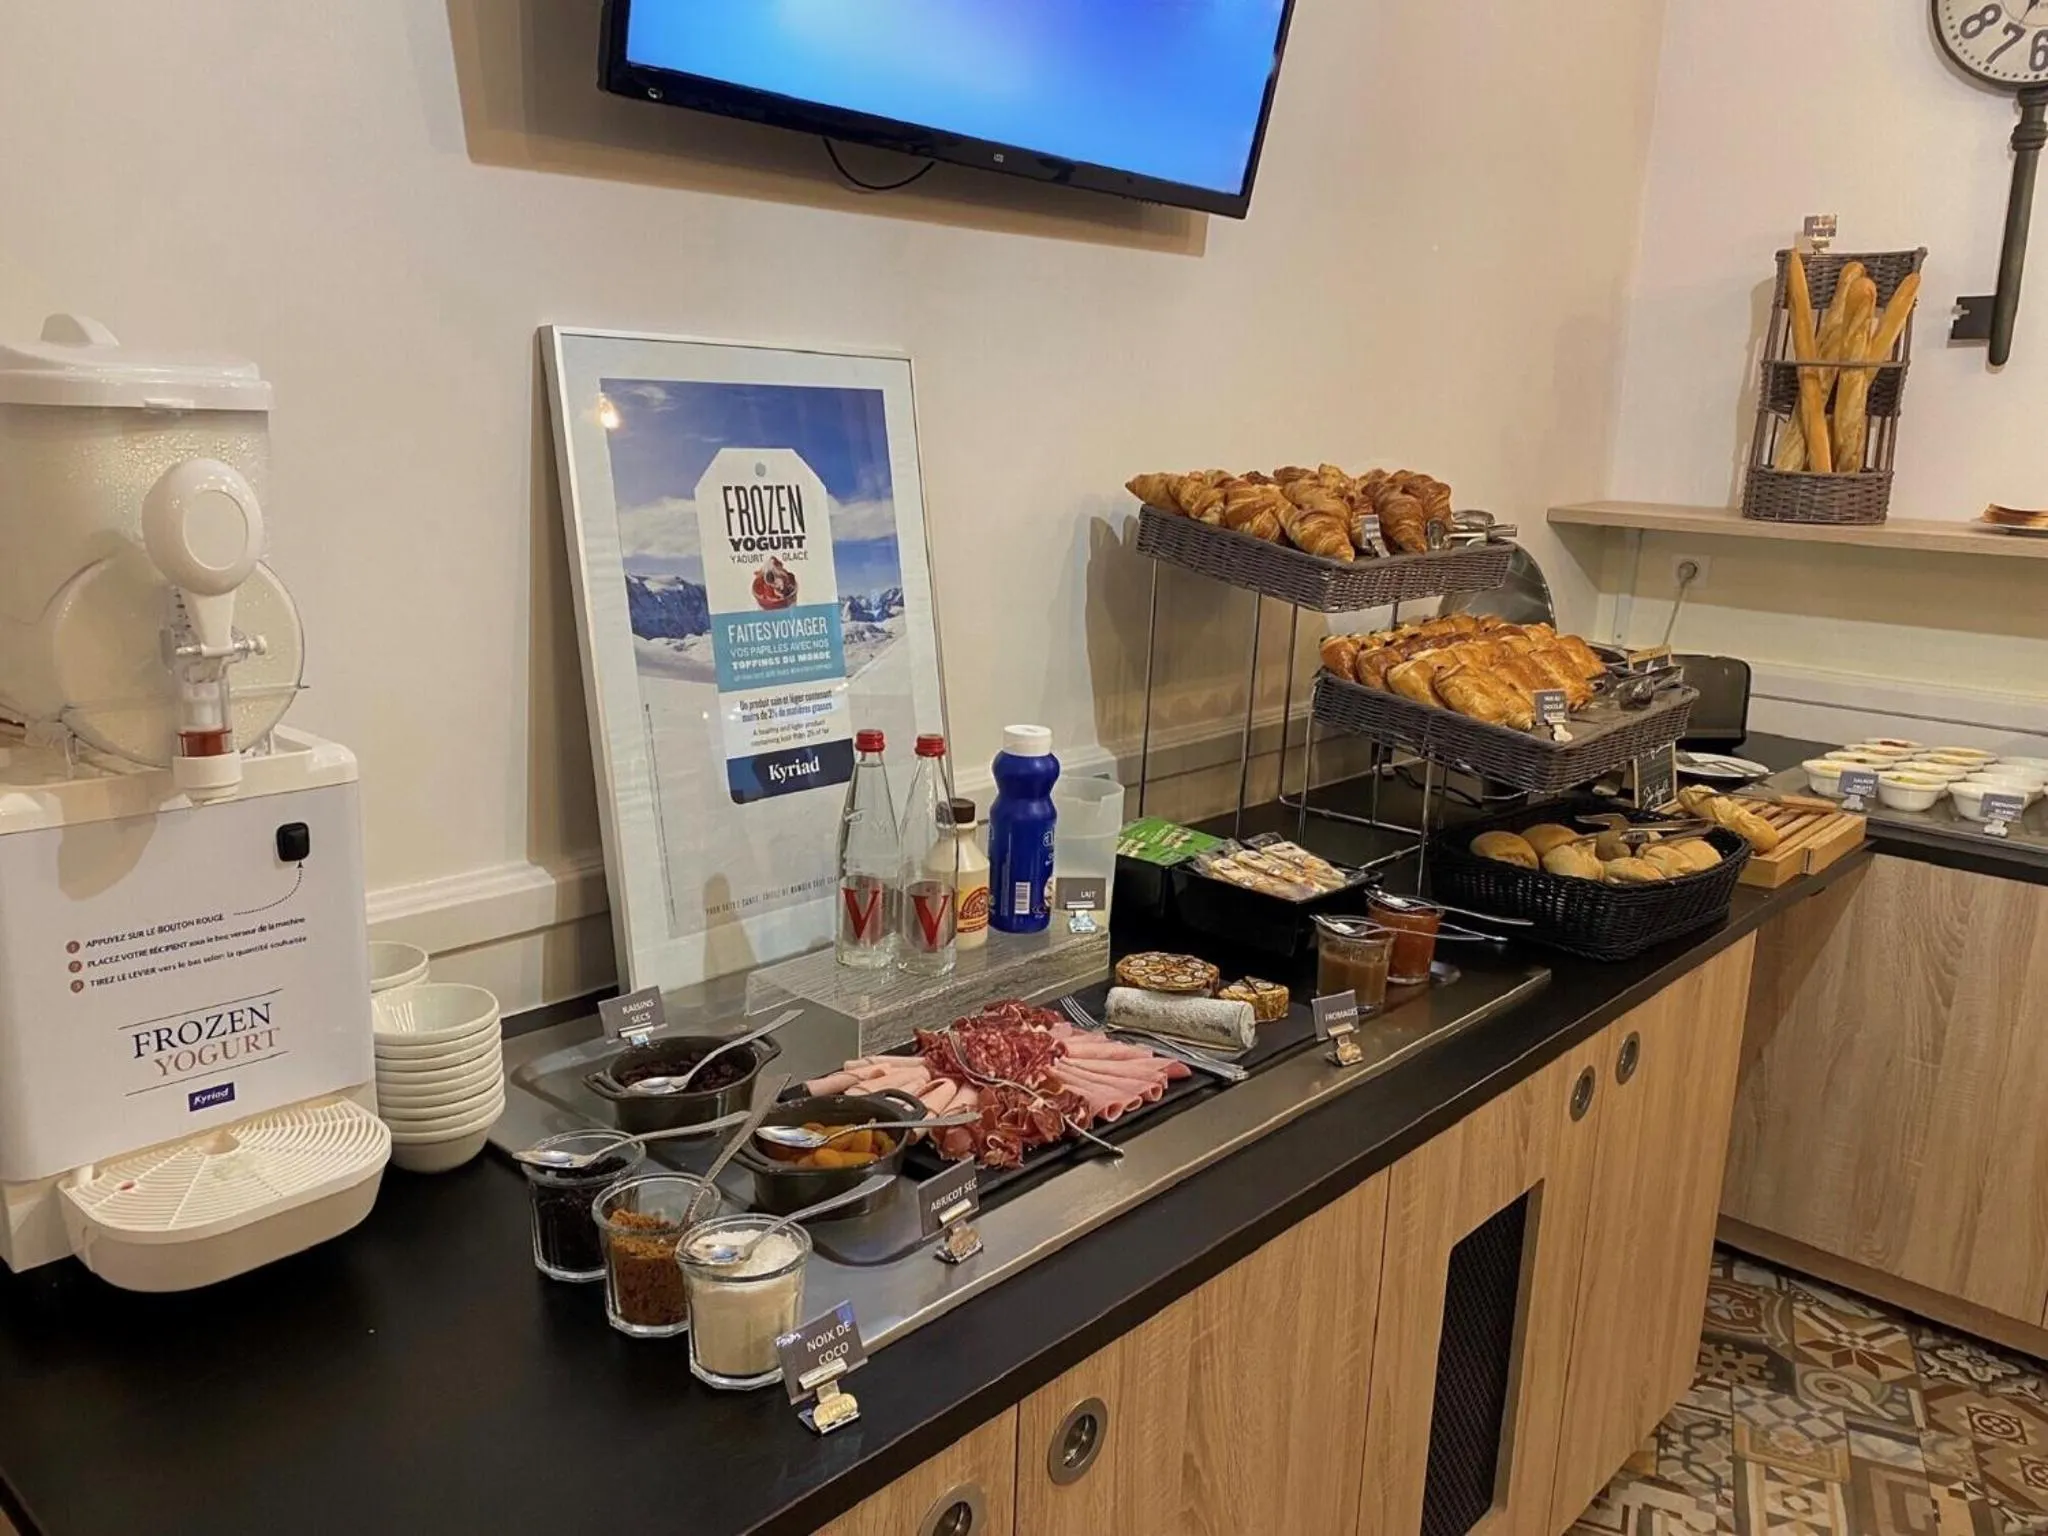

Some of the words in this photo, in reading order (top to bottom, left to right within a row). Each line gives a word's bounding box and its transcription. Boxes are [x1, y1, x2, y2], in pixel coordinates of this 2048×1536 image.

[1960, 3, 2002, 39] 8
[1986, 22, 2026, 64] 7
[722, 484, 806, 537] FROZEN
[728, 535, 806, 552] YOGURT
[729, 553, 764, 564] YAOURT
[727, 621, 772, 644] FAITES
[772, 616, 828, 639] VOYAGER
[730, 647, 750, 658] VOS
[732, 656, 781, 670] TOPPINGS
[768, 755, 820, 784] Kyriad
[842, 888, 880, 939] V
[911, 895, 950, 953] V
[86, 934, 126, 948] APPUYEZ
[128, 930, 145, 940] SUR
[146, 927, 156, 937] LE
[157, 920, 195, 934] BOUTON
[196, 913, 225, 926] ROUGE
[87, 955, 121, 968] PLACEZ
[121, 948, 148, 961] VOTRE
[90, 975, 116, 987] TIREZ
[117, 973, 127, 982] LE
[128, 966, 157, 980] LEVIER
[132, 1002, 272, 1059] FROZEN
[153, 1027, 280, 1077] YOGURT
[192, 1087, 230, 1107] Kyriad
[930, 1186, 963, 1213] ABRICOT
[964, 1177, 978, 1193] SEC
[806, 1328, 836, 1353] NOIX
[836, 1320, 852, 1337] DE
[818, 1342, 849, 1366] COCO
